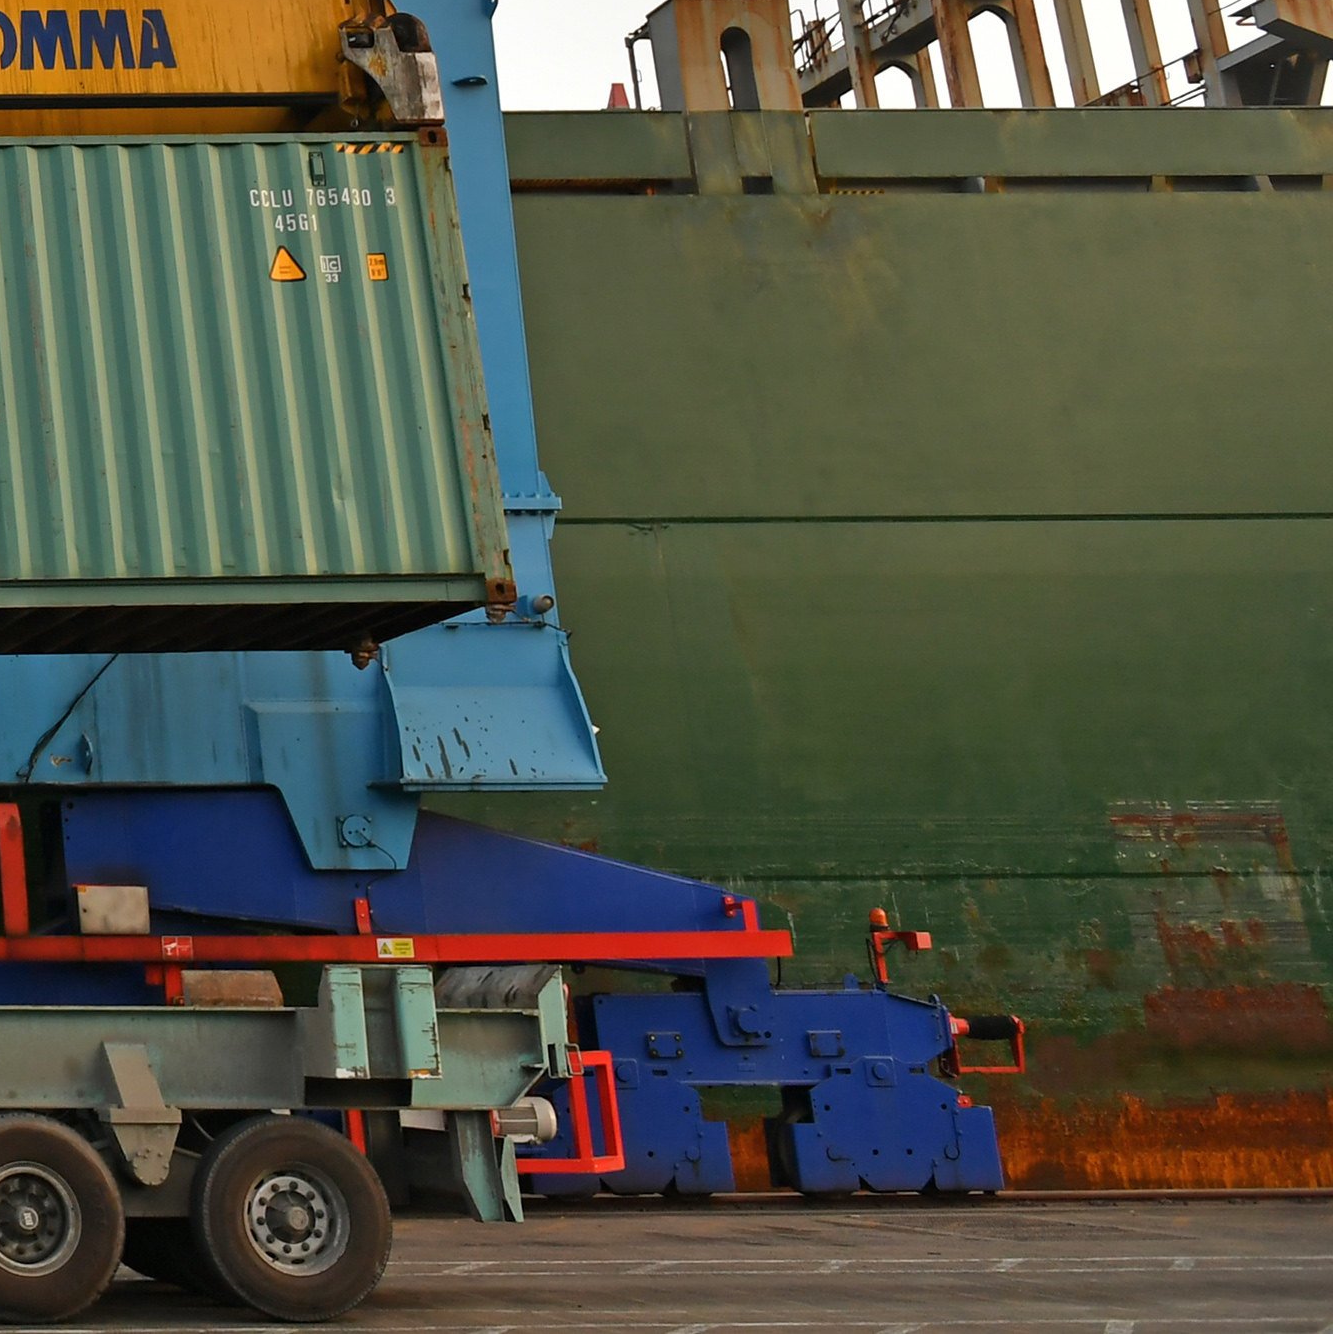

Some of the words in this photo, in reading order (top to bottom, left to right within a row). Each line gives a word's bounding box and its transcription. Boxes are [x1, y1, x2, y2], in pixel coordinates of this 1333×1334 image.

[249, 188, 293, 208] CCLU
[306, 187, 371, 206] 765430
[385, 187, 396, 205] 3
[275, 213, 318, 232] 45G1
[325, 273, 339, 283] 33
